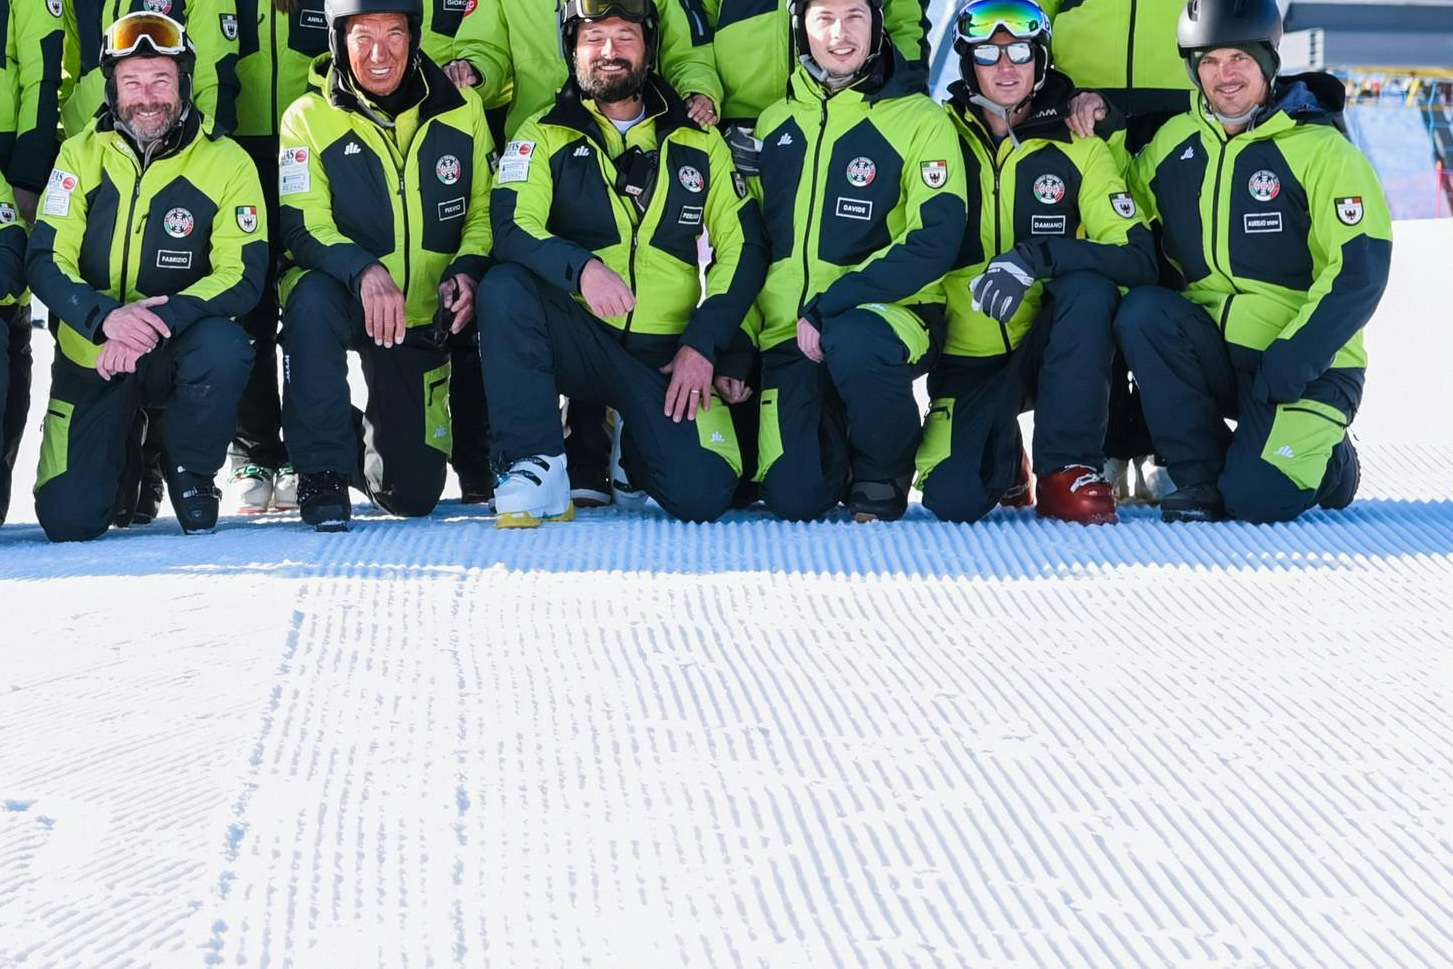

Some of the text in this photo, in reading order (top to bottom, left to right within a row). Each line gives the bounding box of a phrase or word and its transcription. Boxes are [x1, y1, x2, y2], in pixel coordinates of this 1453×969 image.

[843, 203, 865, 214] DAVIDE
[1034, 221, 1062, 229] DAMIANO
[1248, 219, 1266, 227] AURELIO
[161, 255, 187, 263] FABRIZIO
